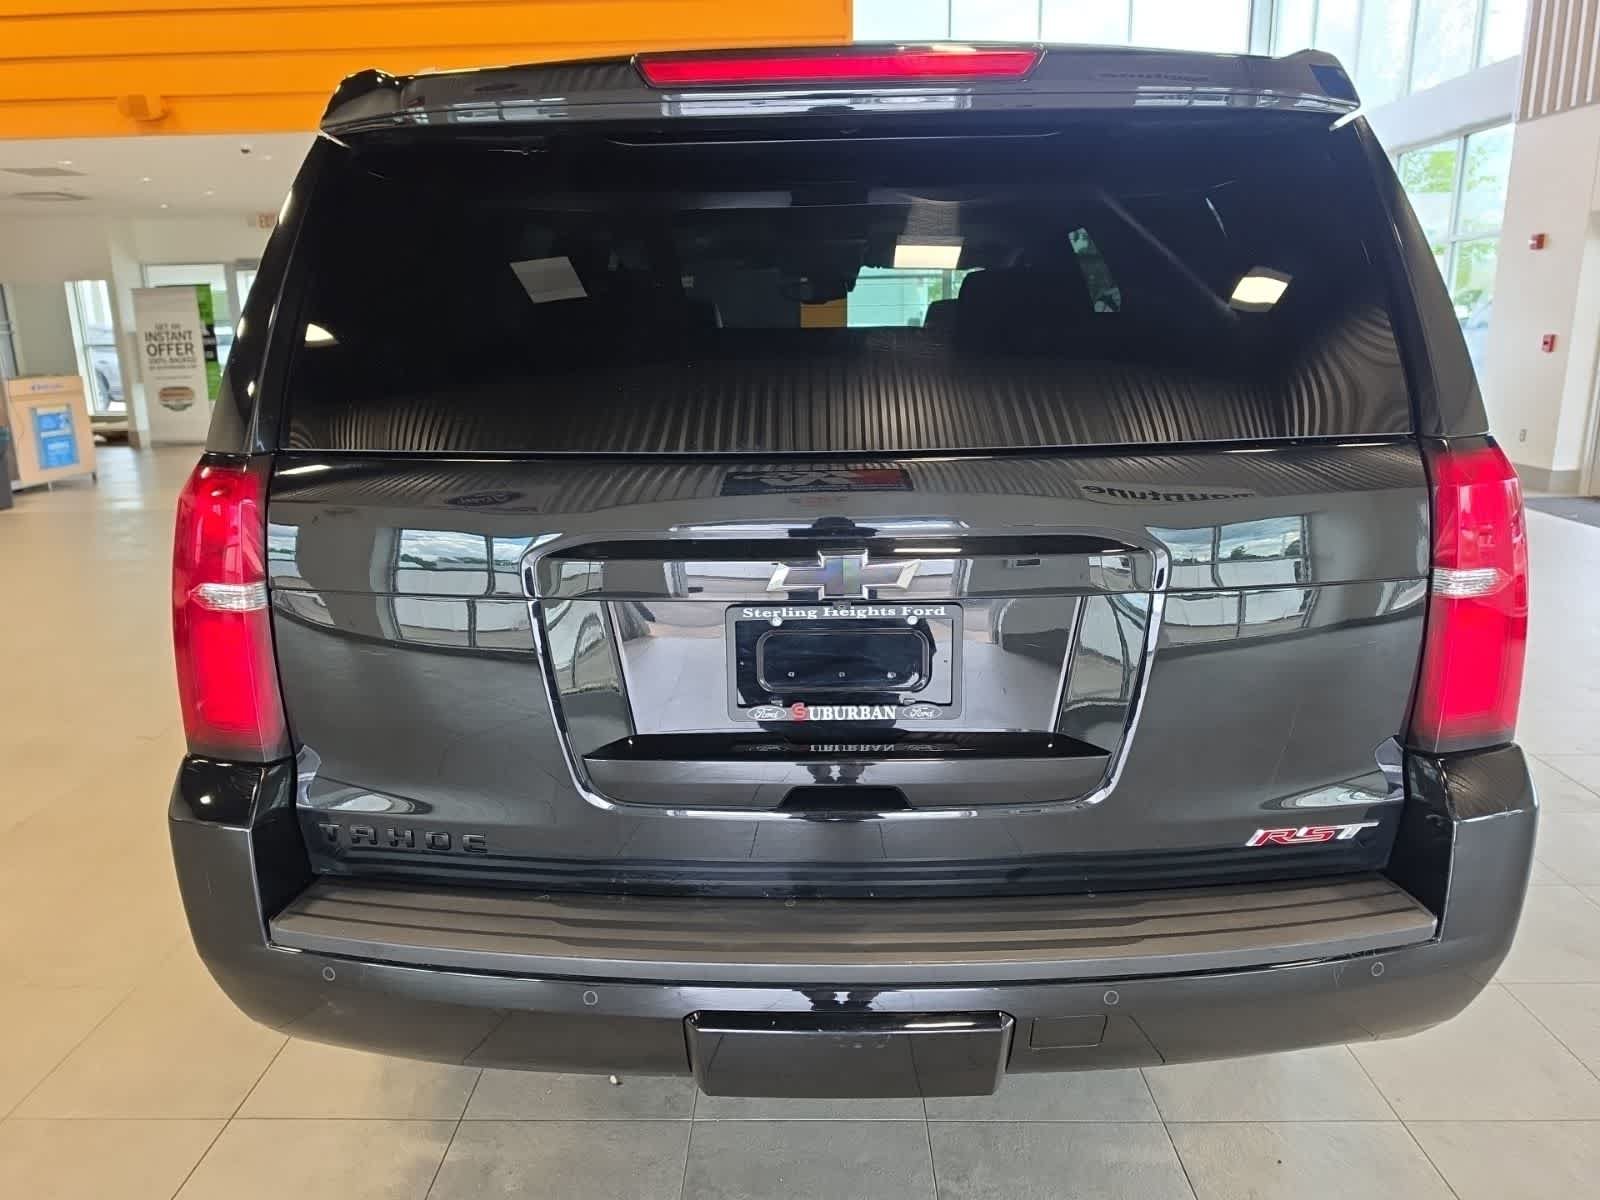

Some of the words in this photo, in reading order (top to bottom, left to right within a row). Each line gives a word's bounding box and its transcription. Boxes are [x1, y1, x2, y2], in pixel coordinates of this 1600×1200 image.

[144, 330, 193, 342] INSTANT
[146, 342, 195, 357] OFFER
[742, 606, 817, 619] Sterling
[823, 606, 896, 617] Heights
[900, 605, 947, 617] Ford
[790, 702, 897, 721] SUBURBAN
[318, 822, 489, 853] TAHOE
[1245, 821, 1381, 847] RST
